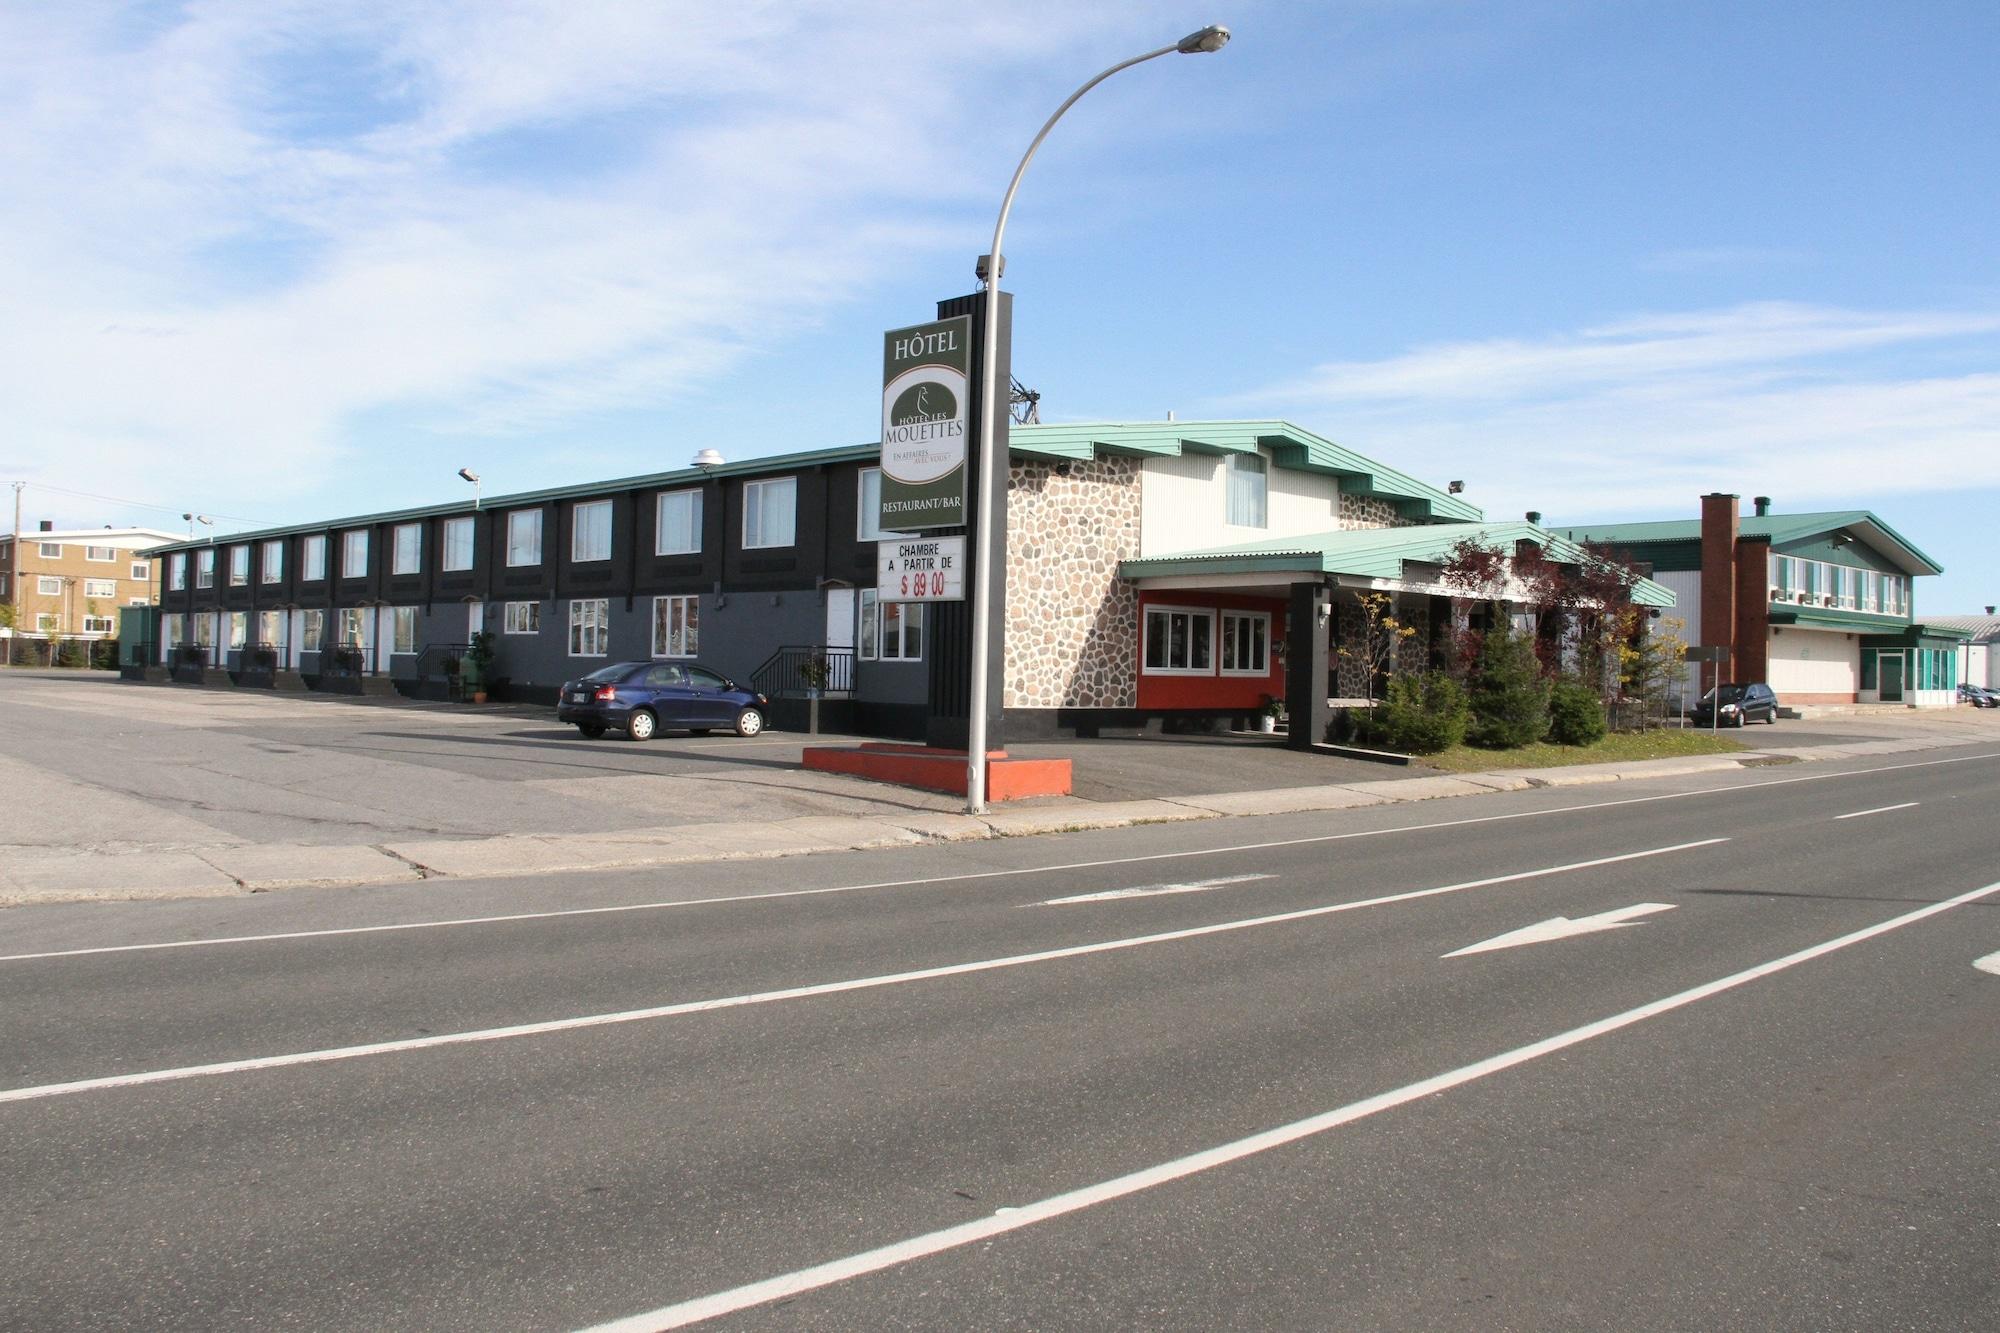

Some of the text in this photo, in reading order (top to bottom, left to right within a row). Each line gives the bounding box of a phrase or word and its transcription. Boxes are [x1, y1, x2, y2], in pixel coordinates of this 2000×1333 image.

[895, 331, 958, 360] HÔTEL
[932, 411, 947, 421] LES
[885, 420, 963, 444] MOUETTES
[883, 496, 961, 513] RESTAURANT/BAR
[899, 543, 939, 557] CHAMBRE
[888, 556, 953, 571] A PARTIR DE
[901, 571, 944, 597] $ 89 00
